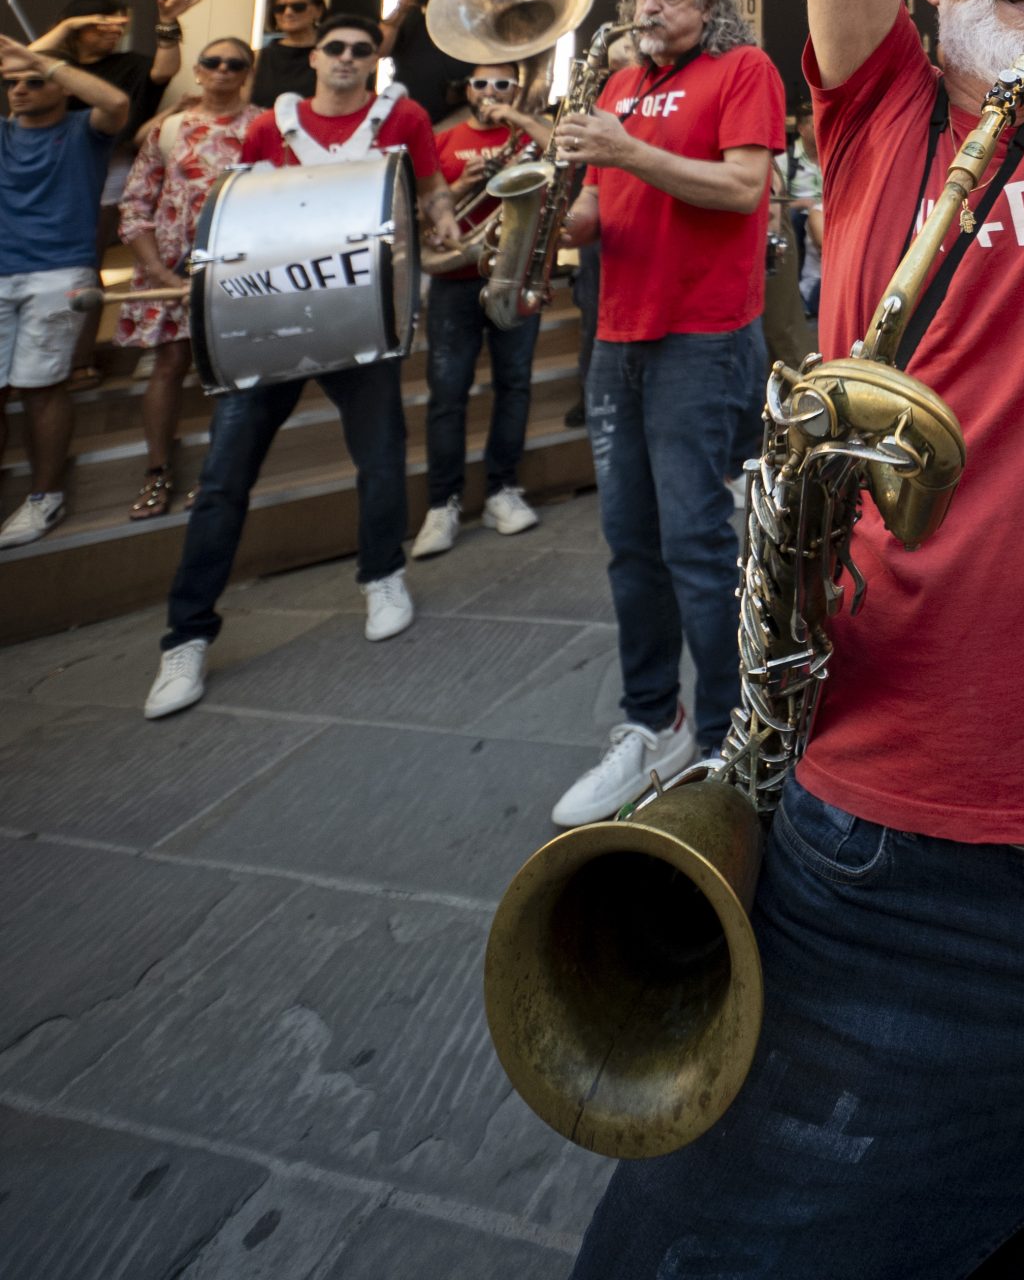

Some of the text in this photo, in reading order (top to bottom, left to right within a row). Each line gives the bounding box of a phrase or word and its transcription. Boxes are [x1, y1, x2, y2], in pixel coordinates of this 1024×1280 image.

[641, 90, 686, 117] OFF
[219, 246, 370, 298] FUNK OFF
